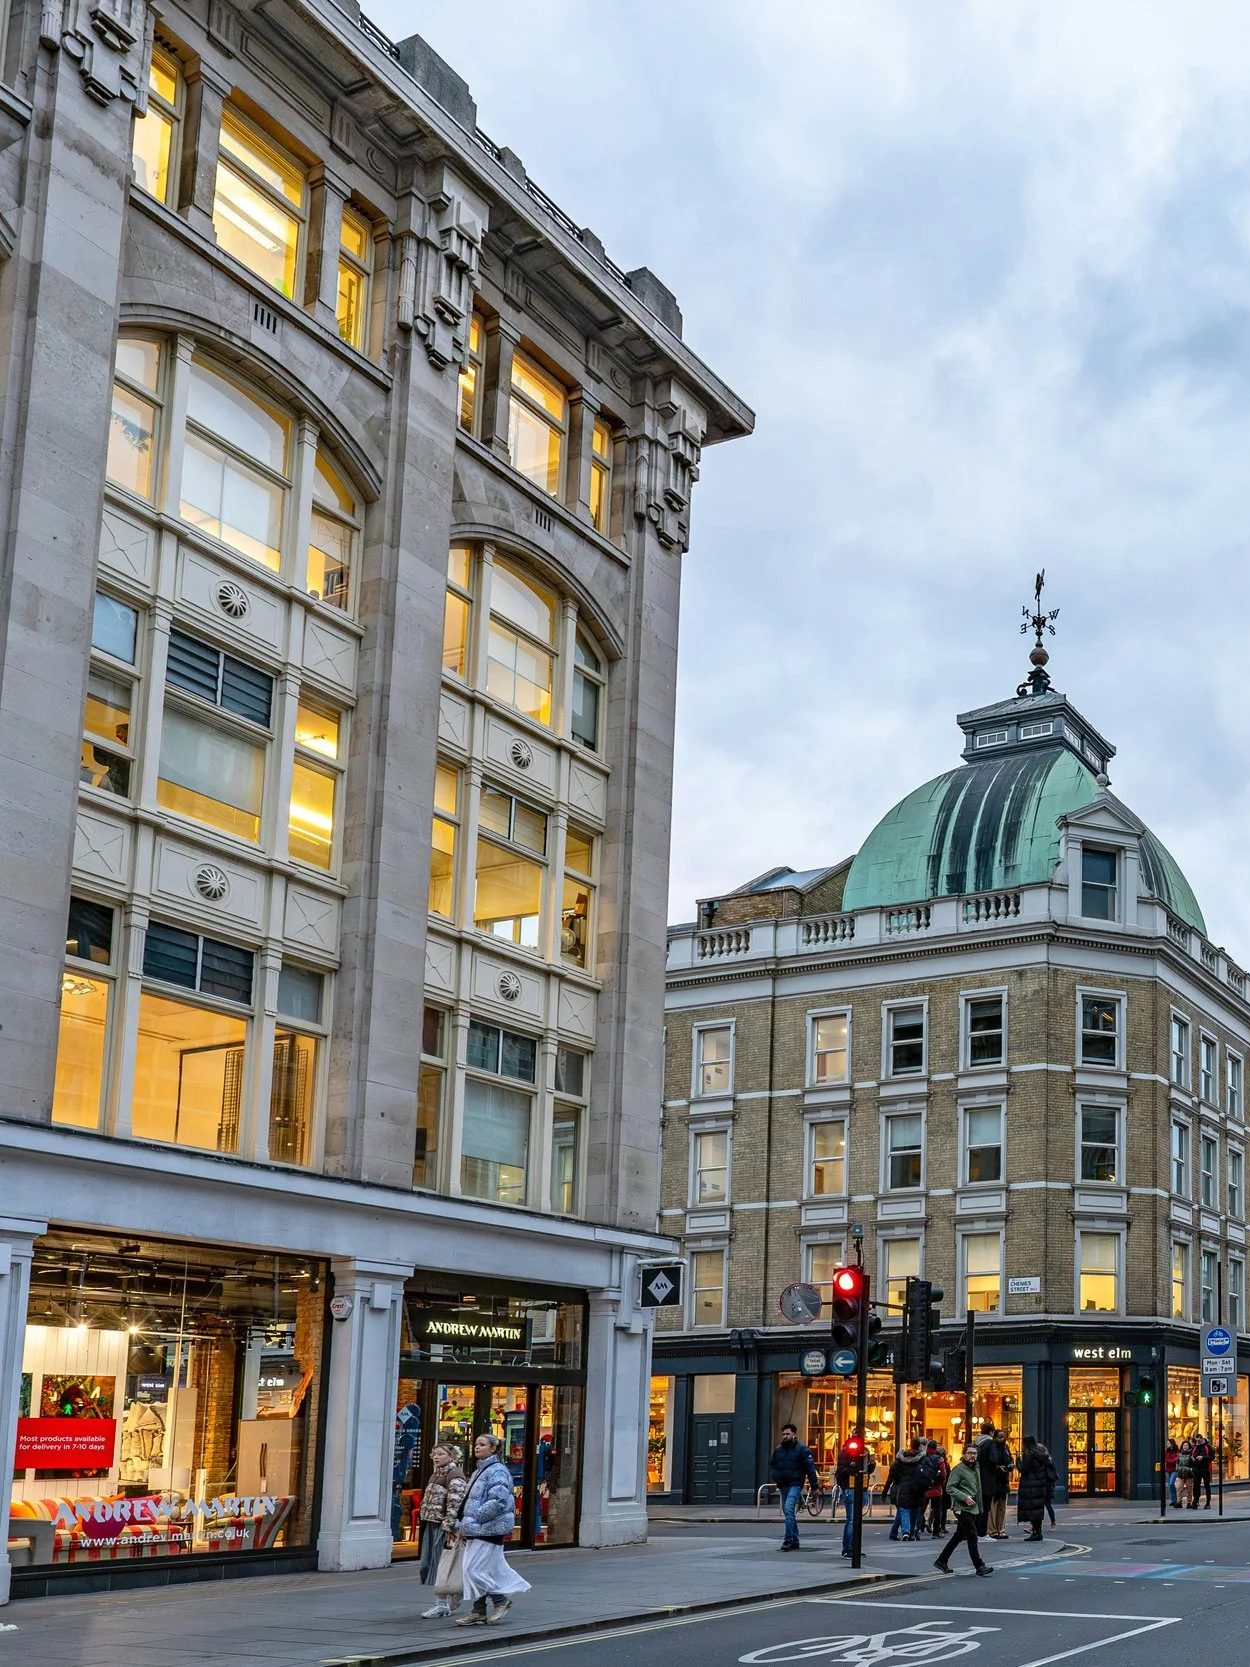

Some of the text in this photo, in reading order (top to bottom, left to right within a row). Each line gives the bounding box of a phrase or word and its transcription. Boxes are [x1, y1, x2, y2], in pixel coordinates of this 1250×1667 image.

[654, 1282, 668, 1290] AM
[425, 1320, 521, 1340] ANDREW MARTIN
[1074, 1347, 1132, 1359] west elm
[39, 1435, 73, 1443] products
[31, 1443, 62, 1451] delivery
[88, 1443, 105, 1451] days
[51, 1495, 279, 1526] ANDREW MARTIN
